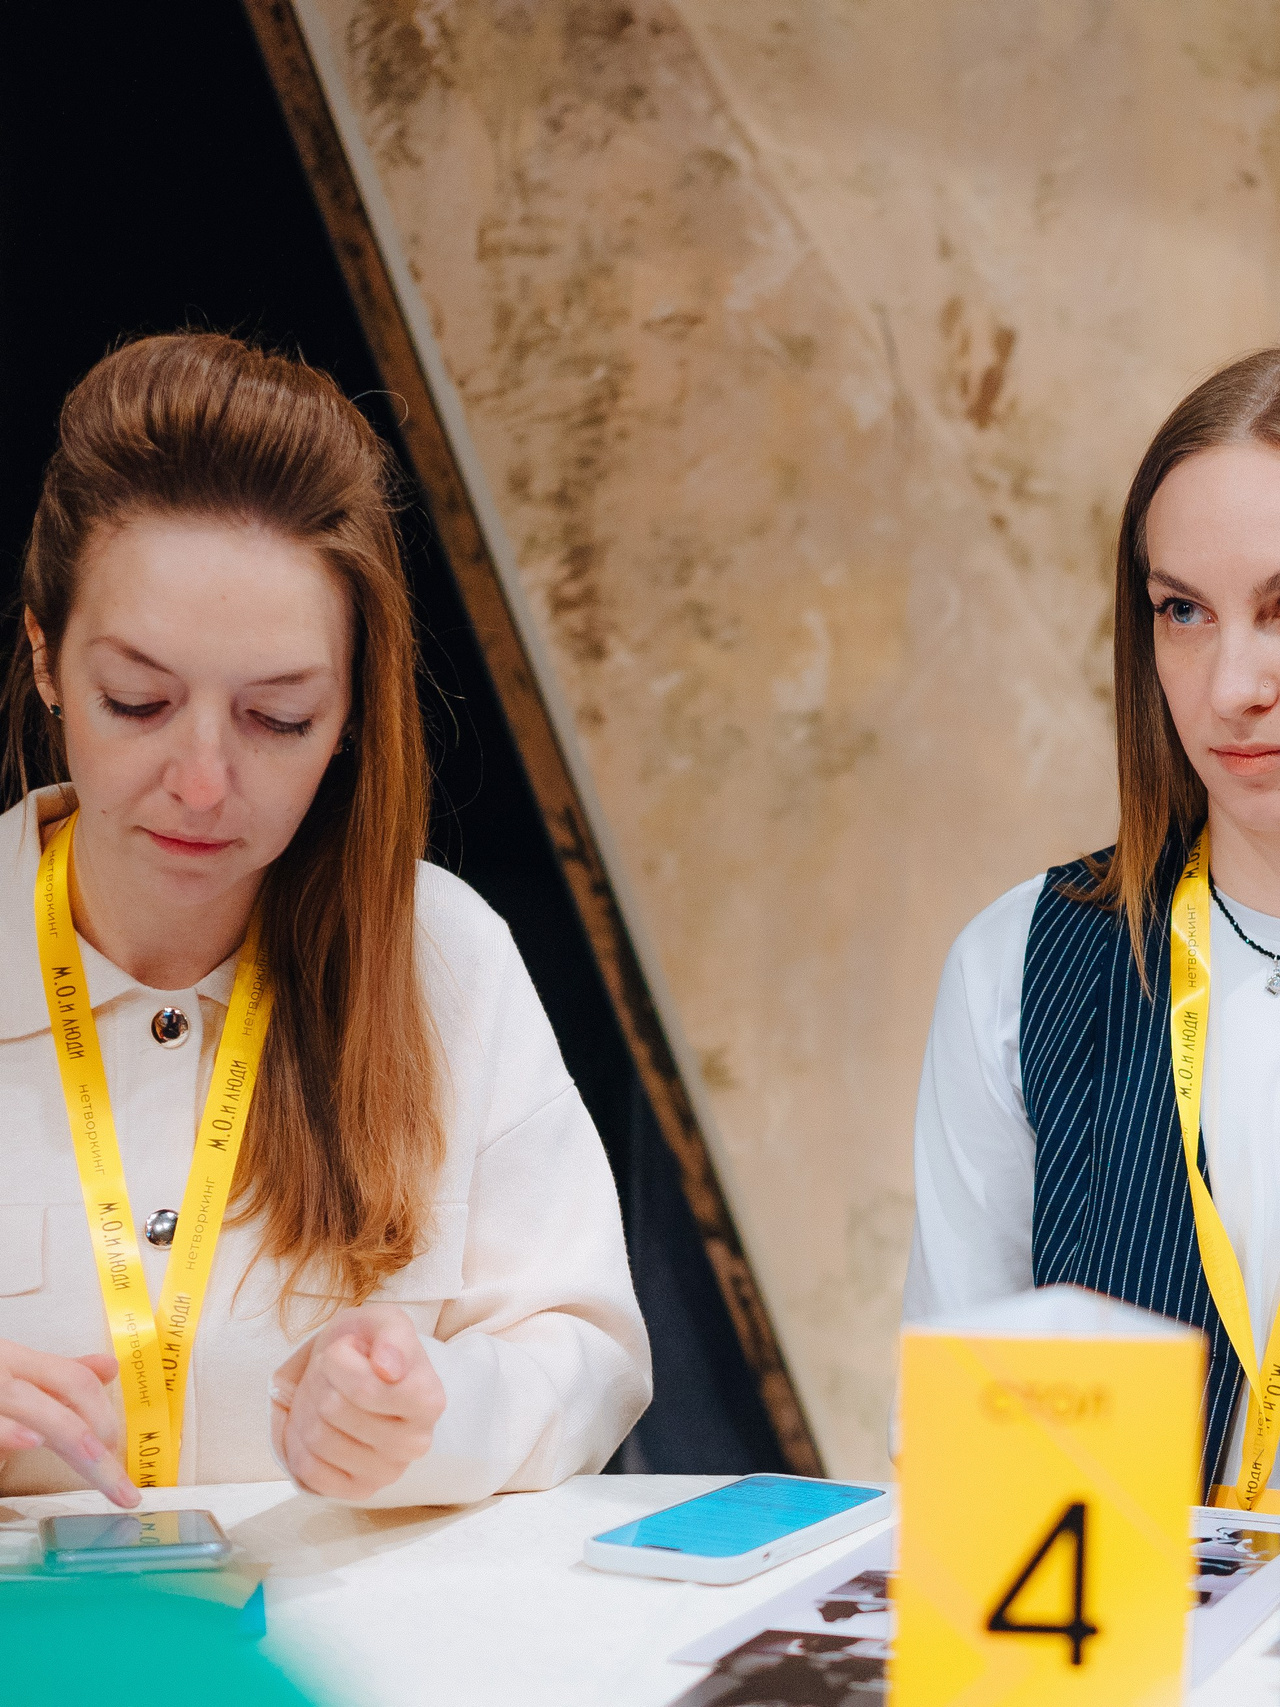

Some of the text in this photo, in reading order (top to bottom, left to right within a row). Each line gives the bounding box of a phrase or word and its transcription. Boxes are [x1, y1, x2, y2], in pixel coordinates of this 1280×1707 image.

[44, 849, 58, 938] нетворкинг
[1187, 903, 1199, 988] нетворкинг
[62, 1018, 85, 1060] ЛЮДИ
[1183, 1010, 1199, 1052] ЛЮДИ
[223, 1059, 247, 1102] ЛЮДИ
[79, 1084, 105, 1175] нетворкинг
[185, 1176, 215, 1270] нетворкинг
[107, 1252, 131, 1291] ЛЮДИ
[167, 1295, 191, 1338] ЛЮДИ
[125, 1312, 151, 1407] нетворкинг
[987, 1502, 1099, 1666] 4
